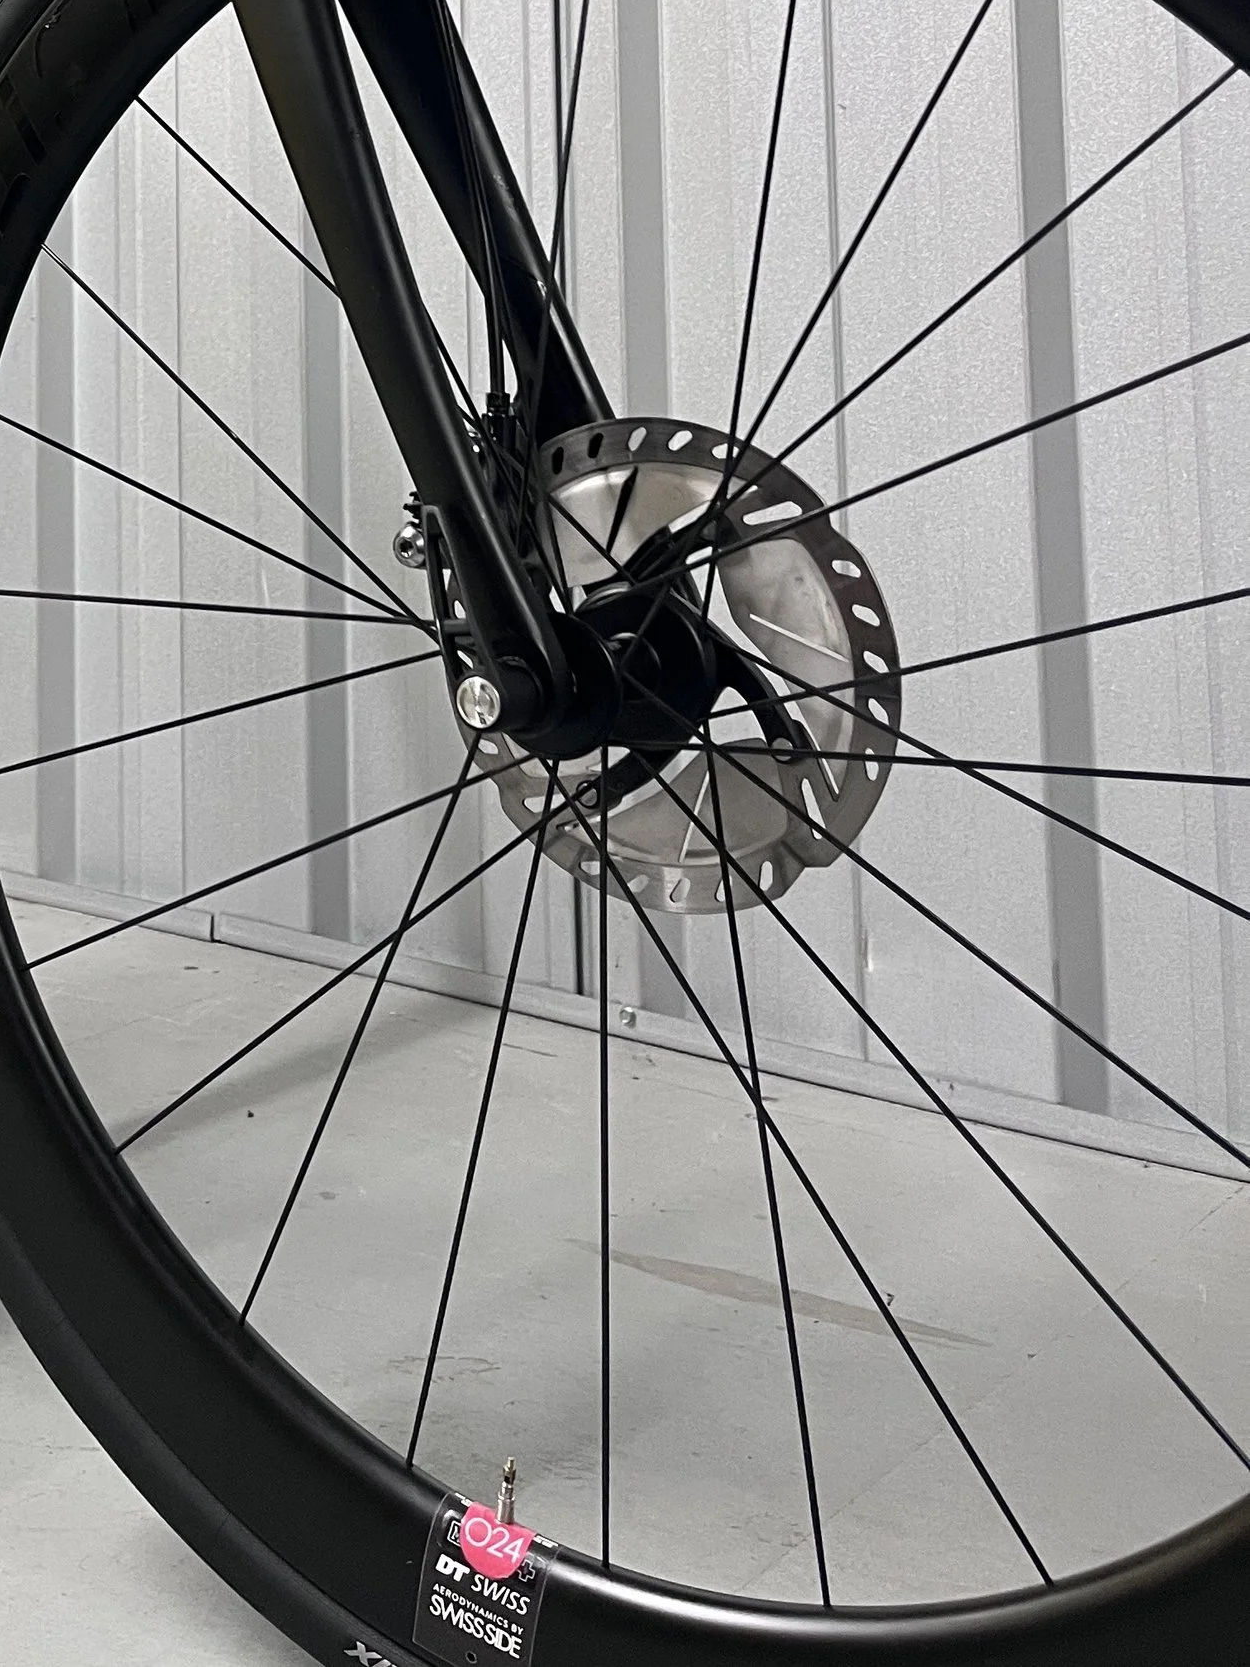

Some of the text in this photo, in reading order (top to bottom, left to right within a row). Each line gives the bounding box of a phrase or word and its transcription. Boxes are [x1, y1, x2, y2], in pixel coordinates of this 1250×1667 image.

[432, 1583, 525, 1636] AERODYNAMICS BY
[435, 1553, 531, 1616] DT SWISS
